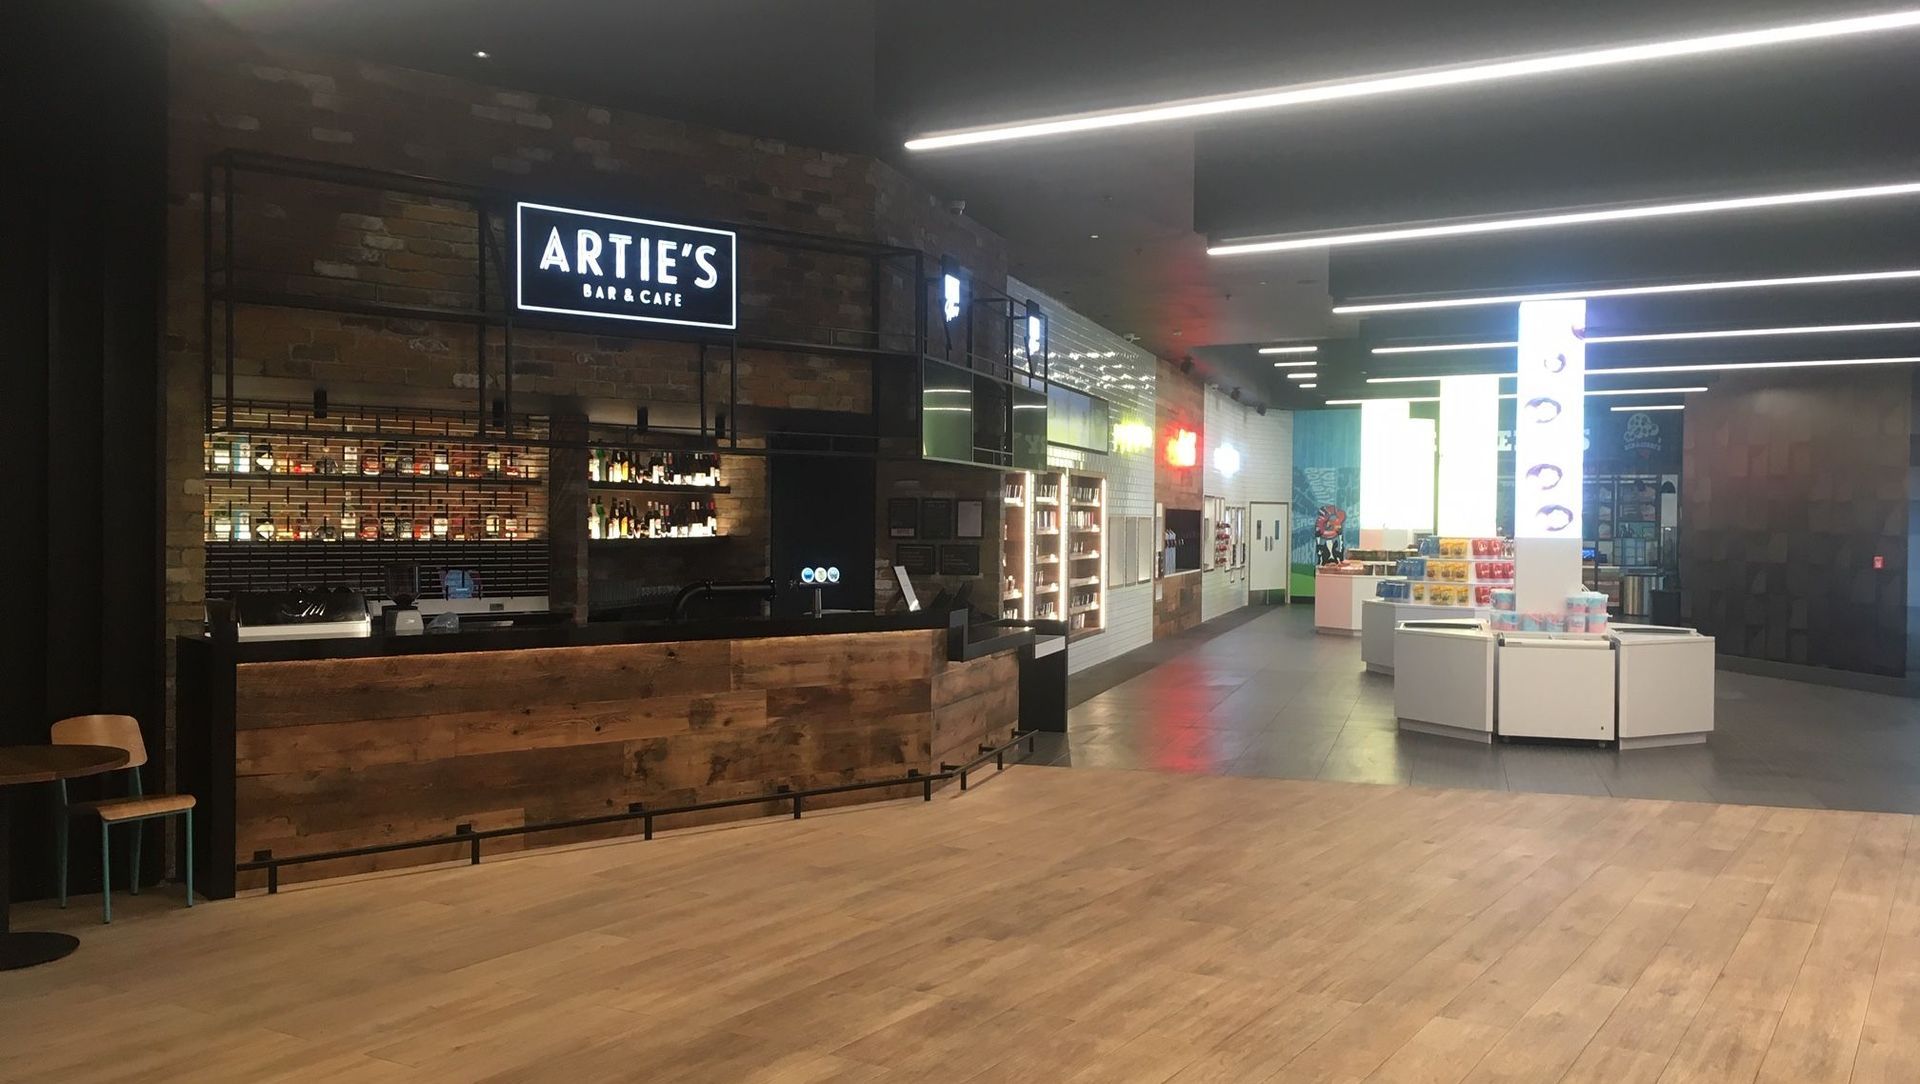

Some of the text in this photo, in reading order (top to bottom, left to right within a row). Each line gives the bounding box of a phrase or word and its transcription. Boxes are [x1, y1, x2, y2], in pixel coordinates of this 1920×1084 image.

[540, 225, 718, 290] ARTIE'S
[583, 283, 682, 307] BAR & CAFE
